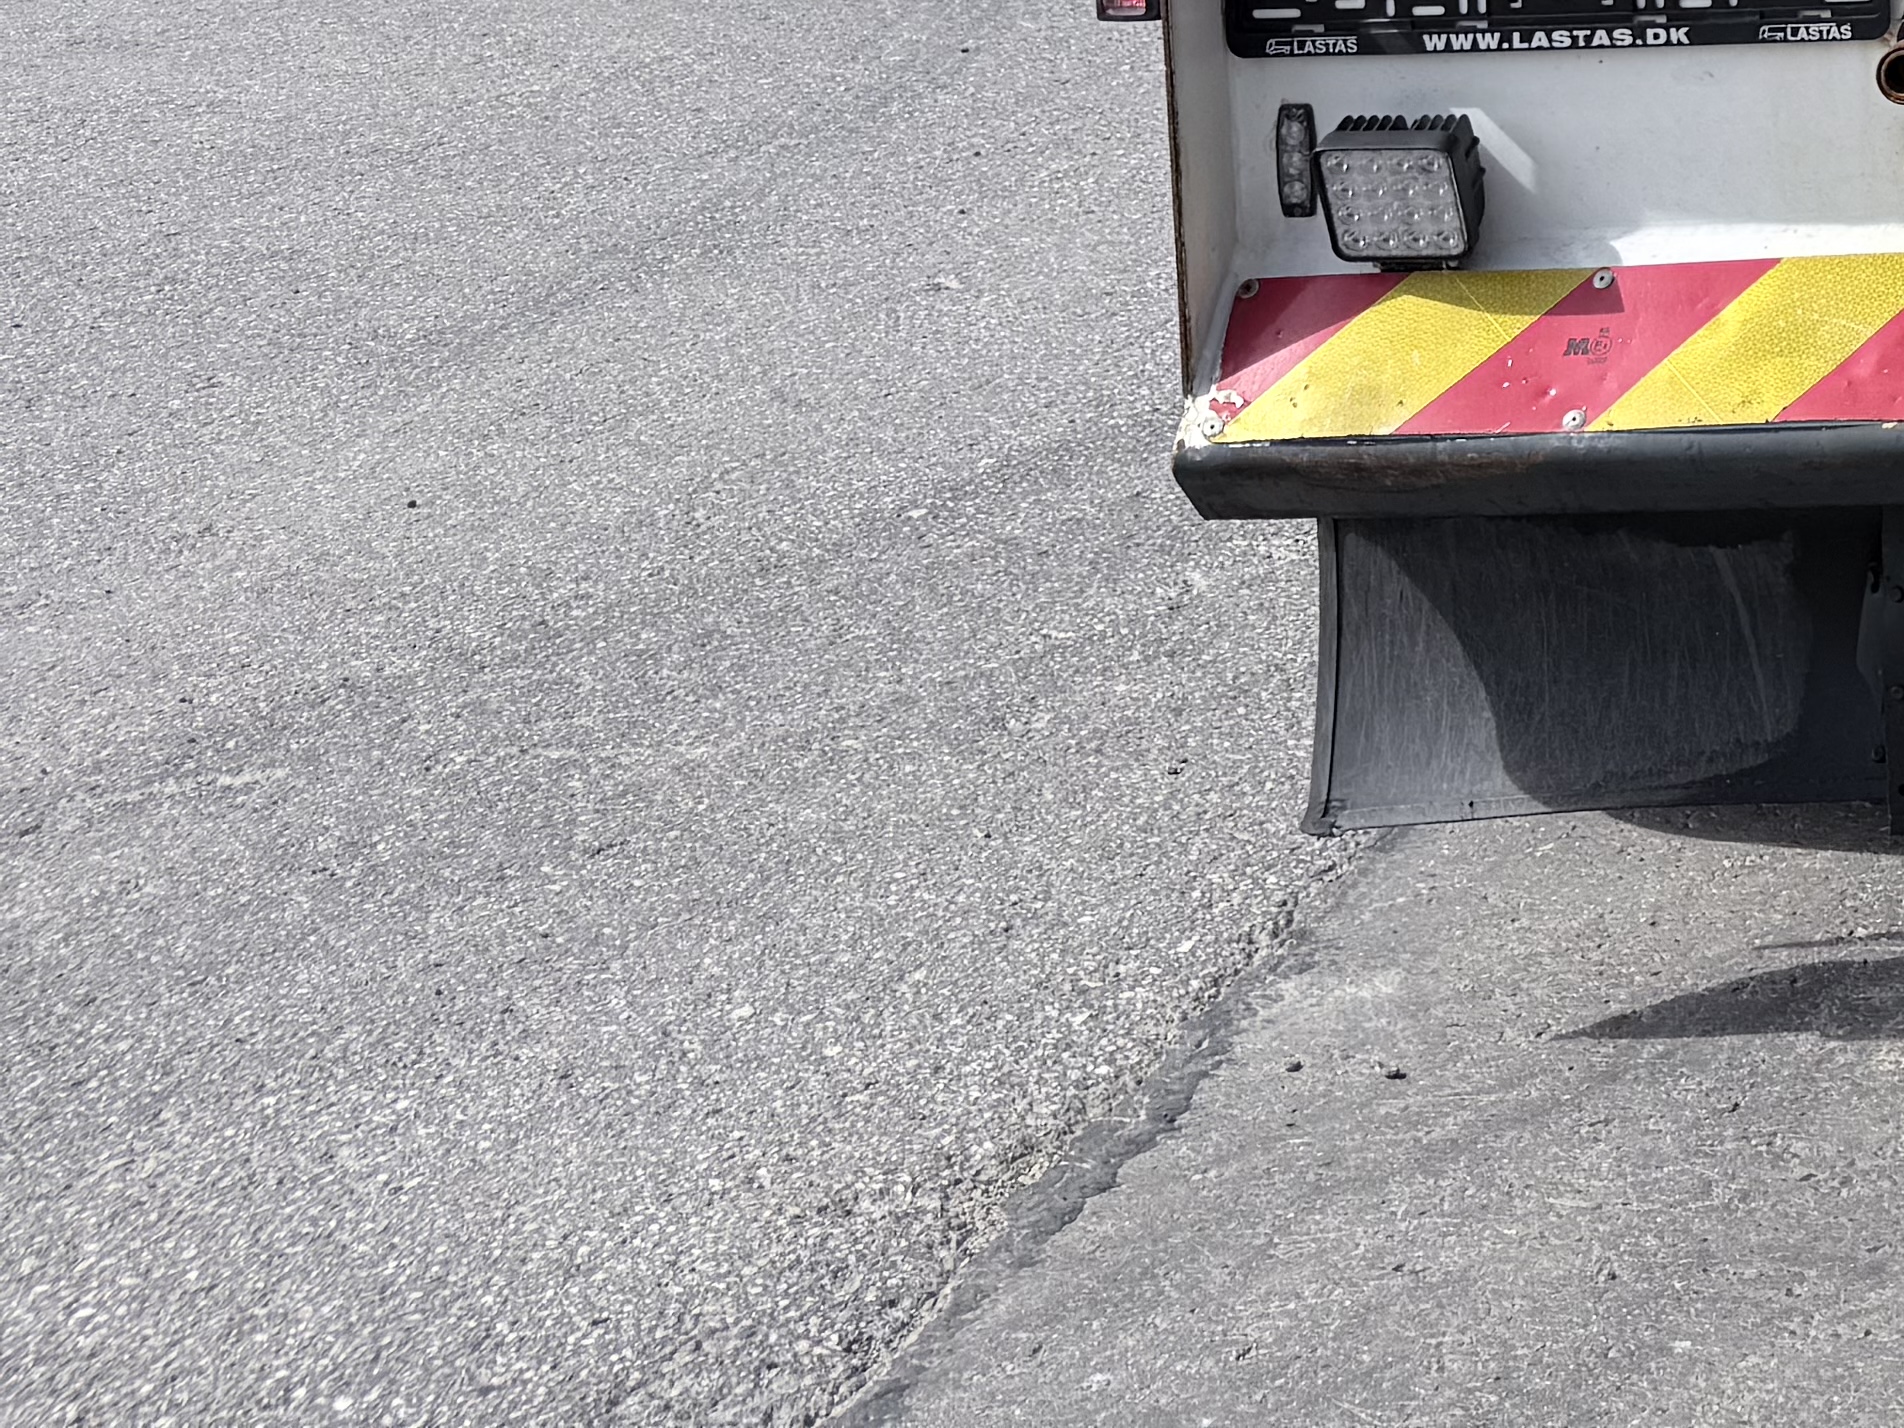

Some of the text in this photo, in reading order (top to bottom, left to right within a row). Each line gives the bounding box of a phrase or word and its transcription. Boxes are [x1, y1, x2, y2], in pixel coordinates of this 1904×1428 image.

[1423, 27, 1690, 51] WWW.LASTAS.DK
[1786, 24, 1852, 41] LASTAS
[1293, 38, 1358, 54] LASTAS
